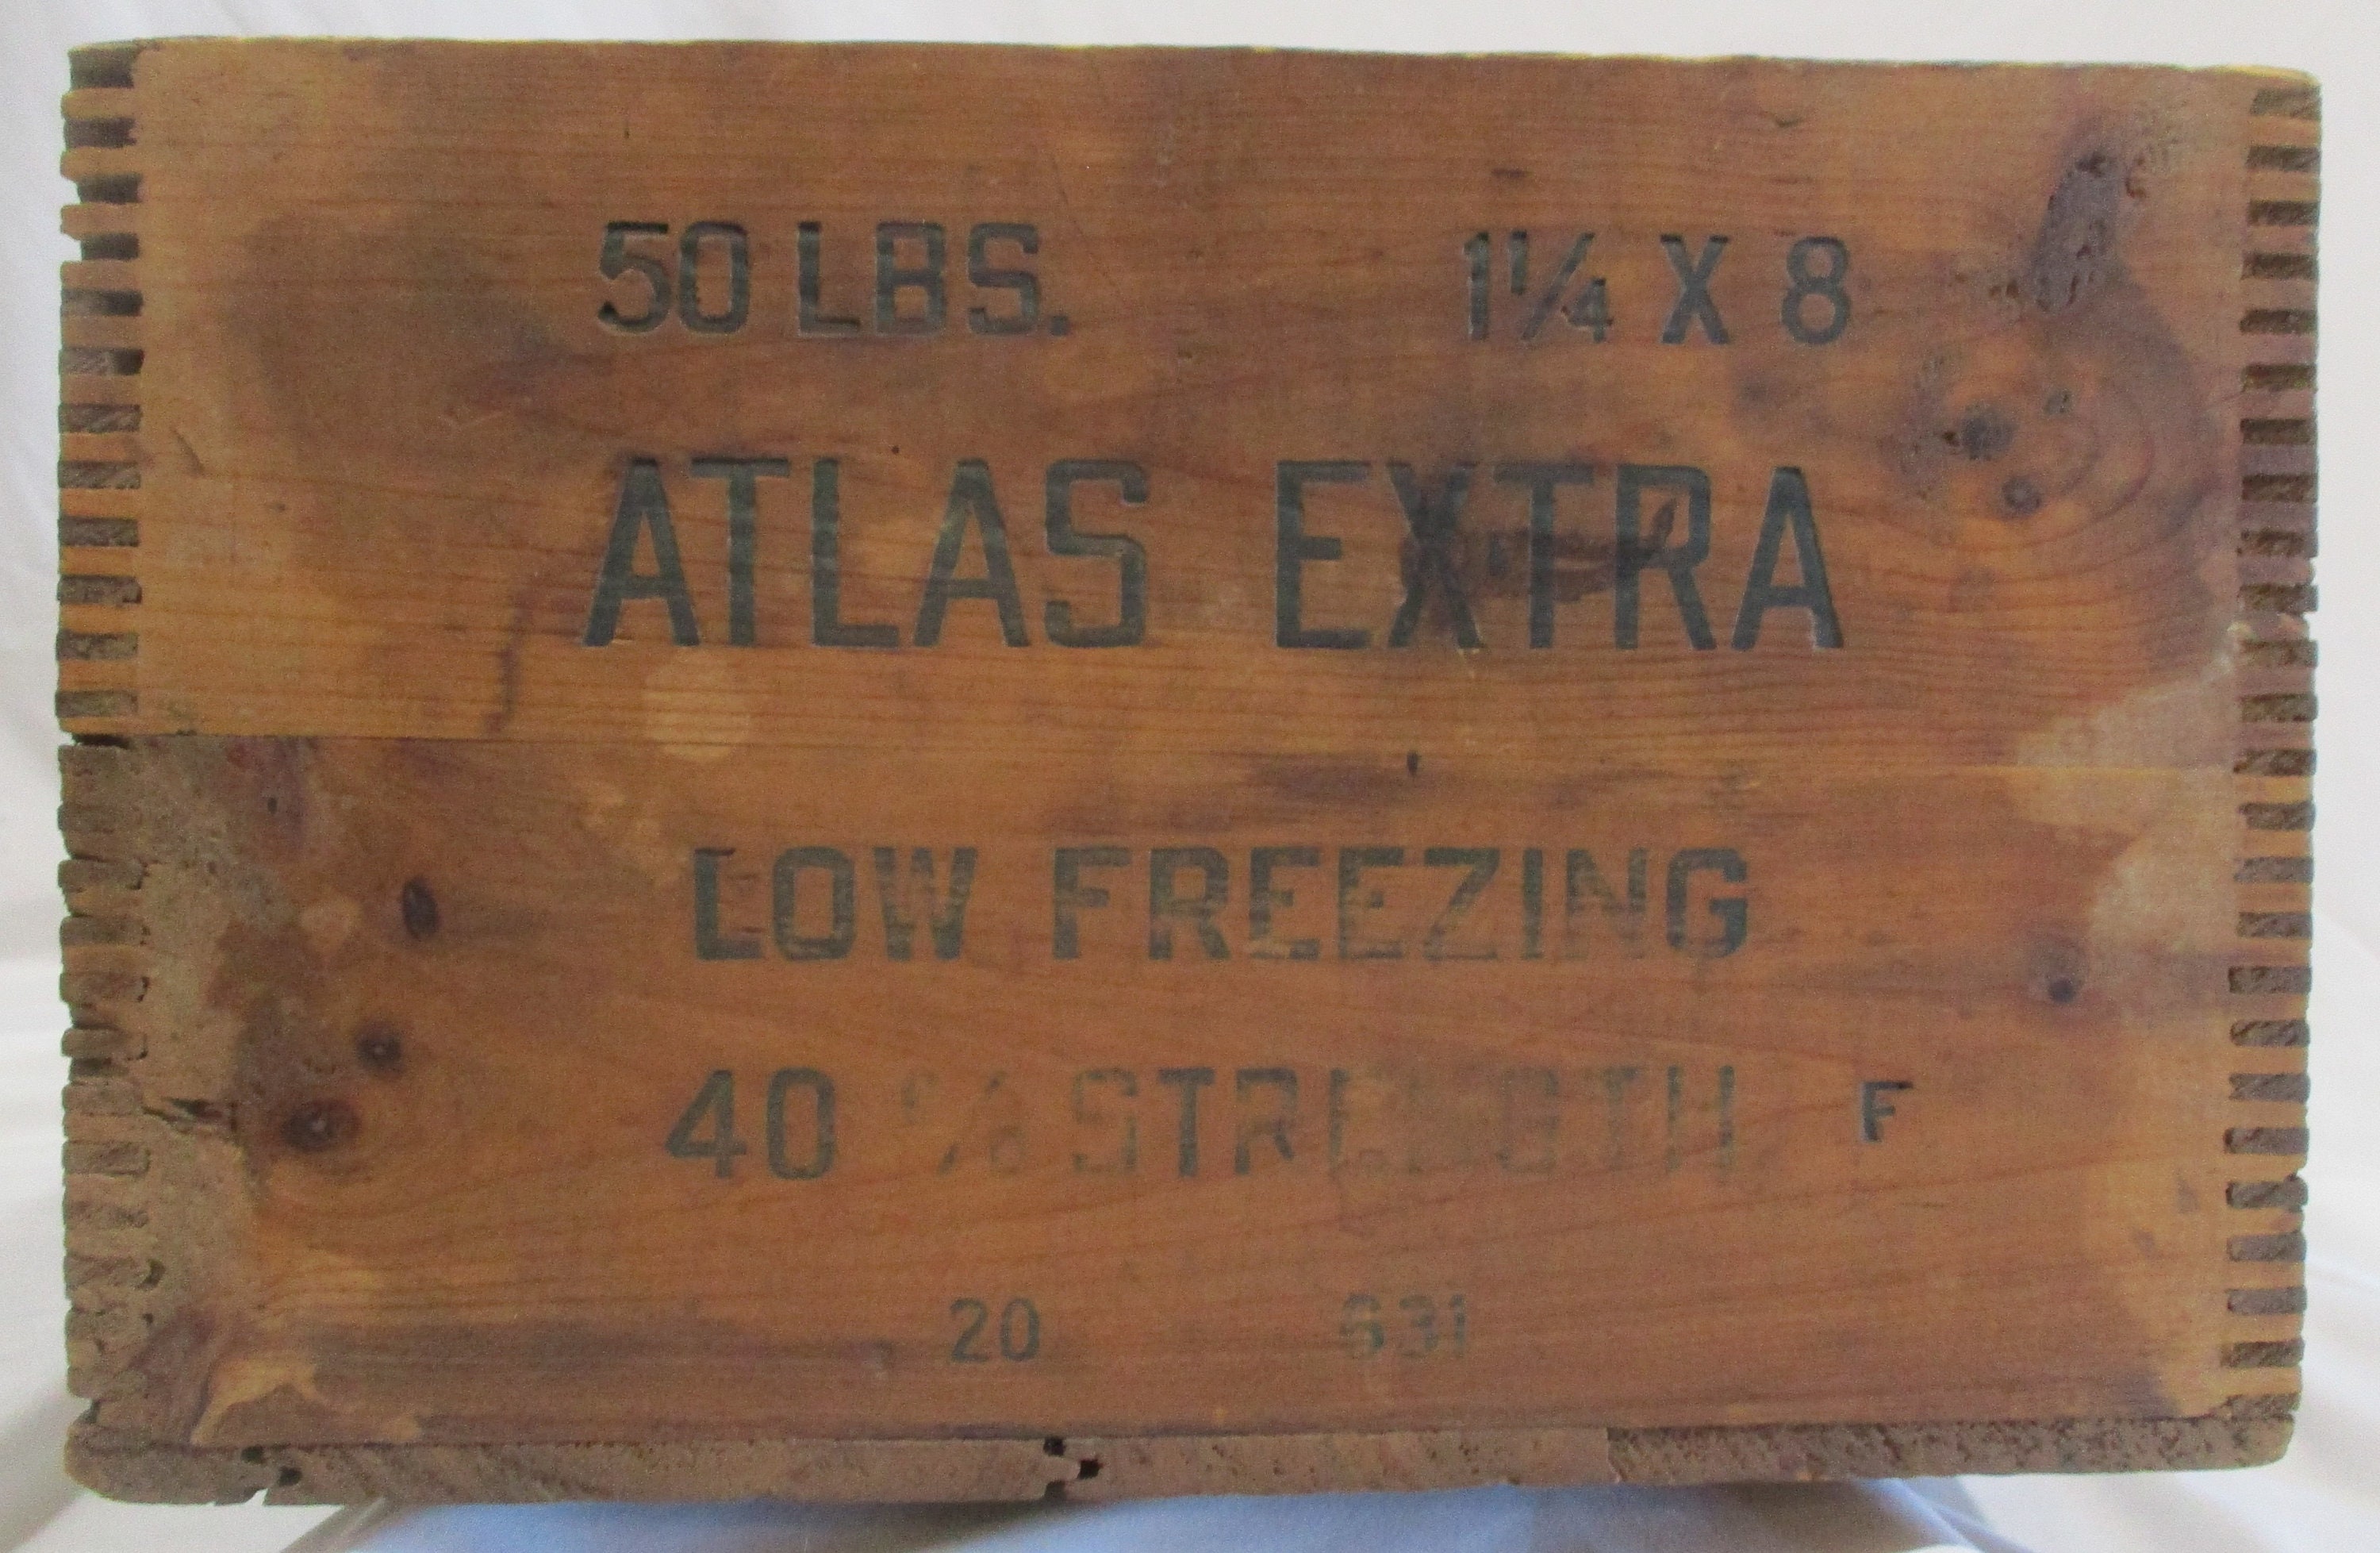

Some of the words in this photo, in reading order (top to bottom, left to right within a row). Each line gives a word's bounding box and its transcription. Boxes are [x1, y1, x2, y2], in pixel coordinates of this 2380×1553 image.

[598, 221, 750, 335] 50
[797, 221, 1069, 336] LBS.
[1659, 234, 1732, 344] X
[1780, 236, 1853, 344] 8
[581, 456, 1148, 648] ATLAS
[1276, 460, 1844, 650] EXTRA
[693, 846, 977, 961] LOW
[1051, 846, 1749, 961] FREEZING
[664, 1067, 838, 1179] 40
[1071, 1065, 1737, 1178] STRGTH
[1860, 1080, 1914, 1143] F
[949, 1296, 1041, 1363] 20
